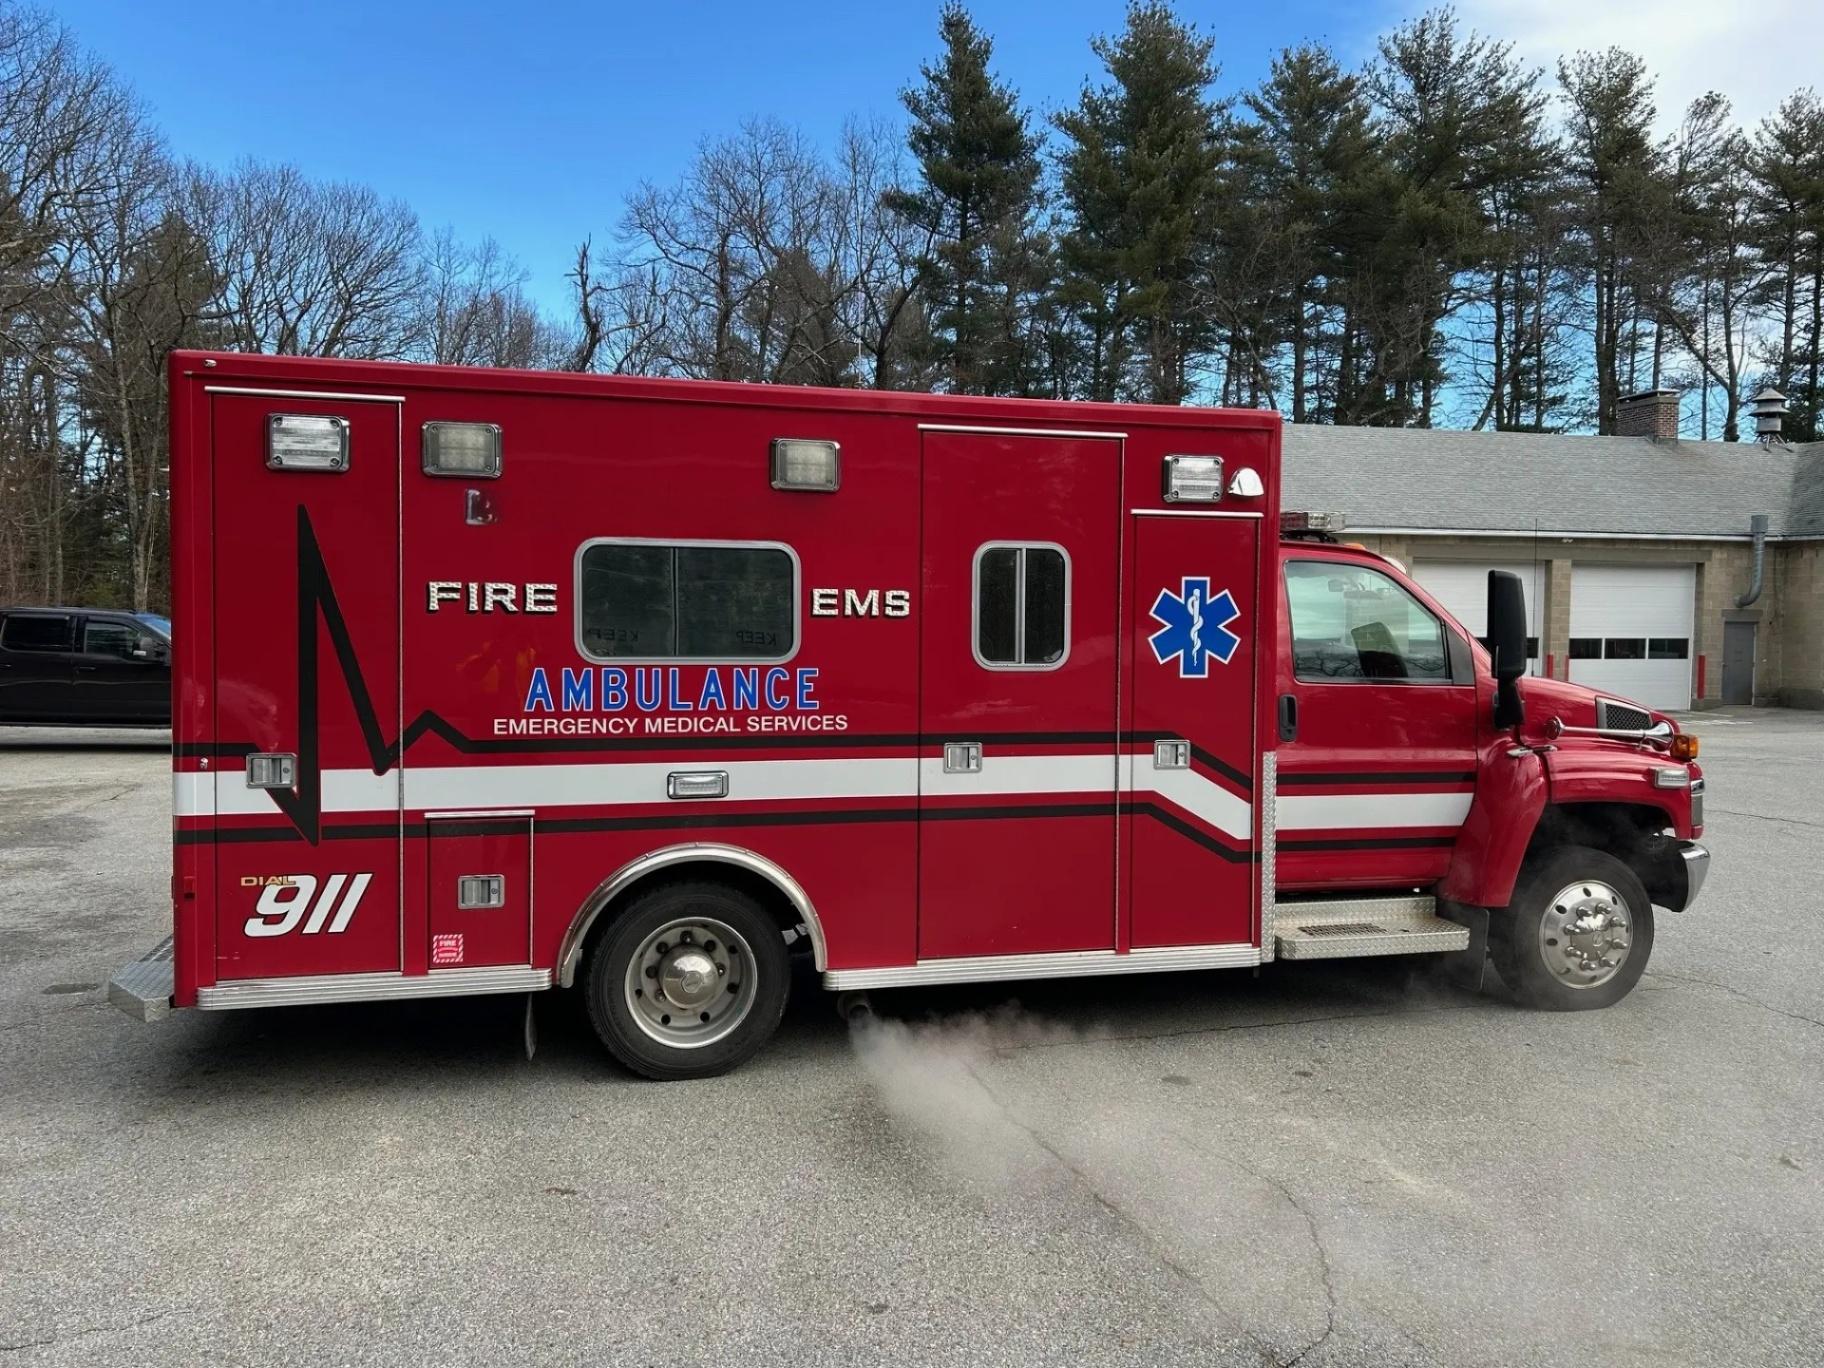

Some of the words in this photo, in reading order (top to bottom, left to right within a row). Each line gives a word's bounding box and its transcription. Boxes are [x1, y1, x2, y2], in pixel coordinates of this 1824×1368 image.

[428, 581, 558, 612] FIRE
[812, 588, 910, 617] EMS
[523, 667, 820, 713] AMBULANCE
[493, 717, 639, 735] EMERGENCY
[645, 716, 741, 733] MEDICAL
[746, 714, 848, 732] SERVICES
[240, 875, 296, 886] DIAL
[243, 873, 373, 937] 911
